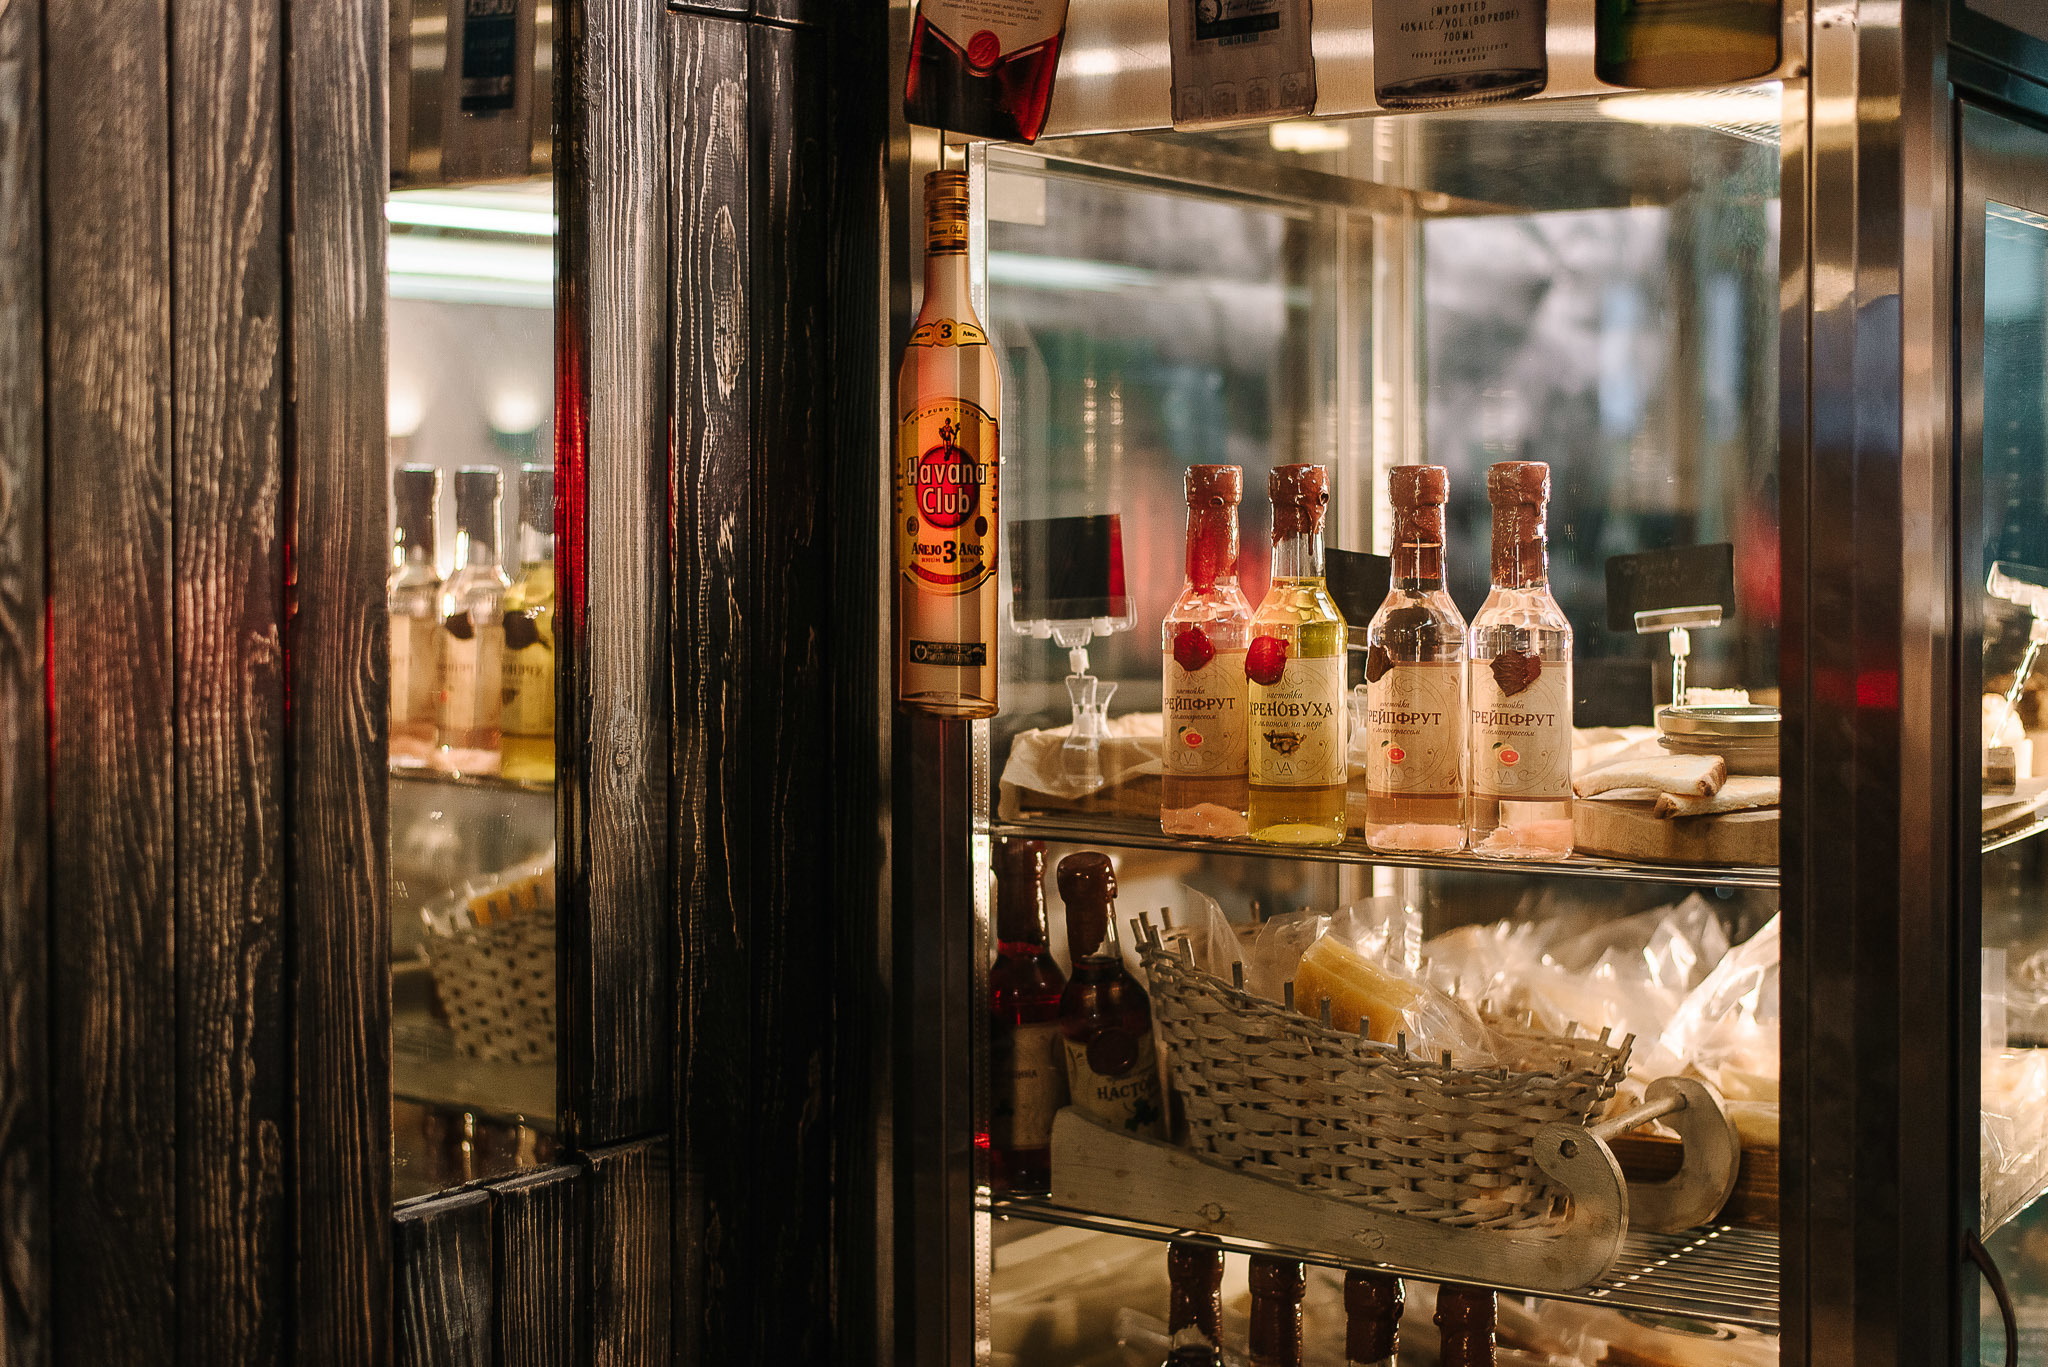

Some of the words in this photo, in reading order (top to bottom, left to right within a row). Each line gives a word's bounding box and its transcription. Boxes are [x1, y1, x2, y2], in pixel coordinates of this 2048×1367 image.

[1431, 1, 1486, 17] IMPORTED
[940, 323, 953, 339] 3
[907, 456, 987, 486] Havana
[922, 487, 970, 515] Club
[911, 541, 943, 556] AÑEJO
[943, 540, 957, 564] 3
[959, 542, 985, 556] AÑOS
[1164, 696, 1235, 711] РЕЙПФРУТ
[1249, 701, 1333, 718] ХРЕНОВУХА
[1368, 709, 1441, 726] РЕЙПФРУТ
[1472, 710, 1555, 727] ГРЕЙПФРУТ
